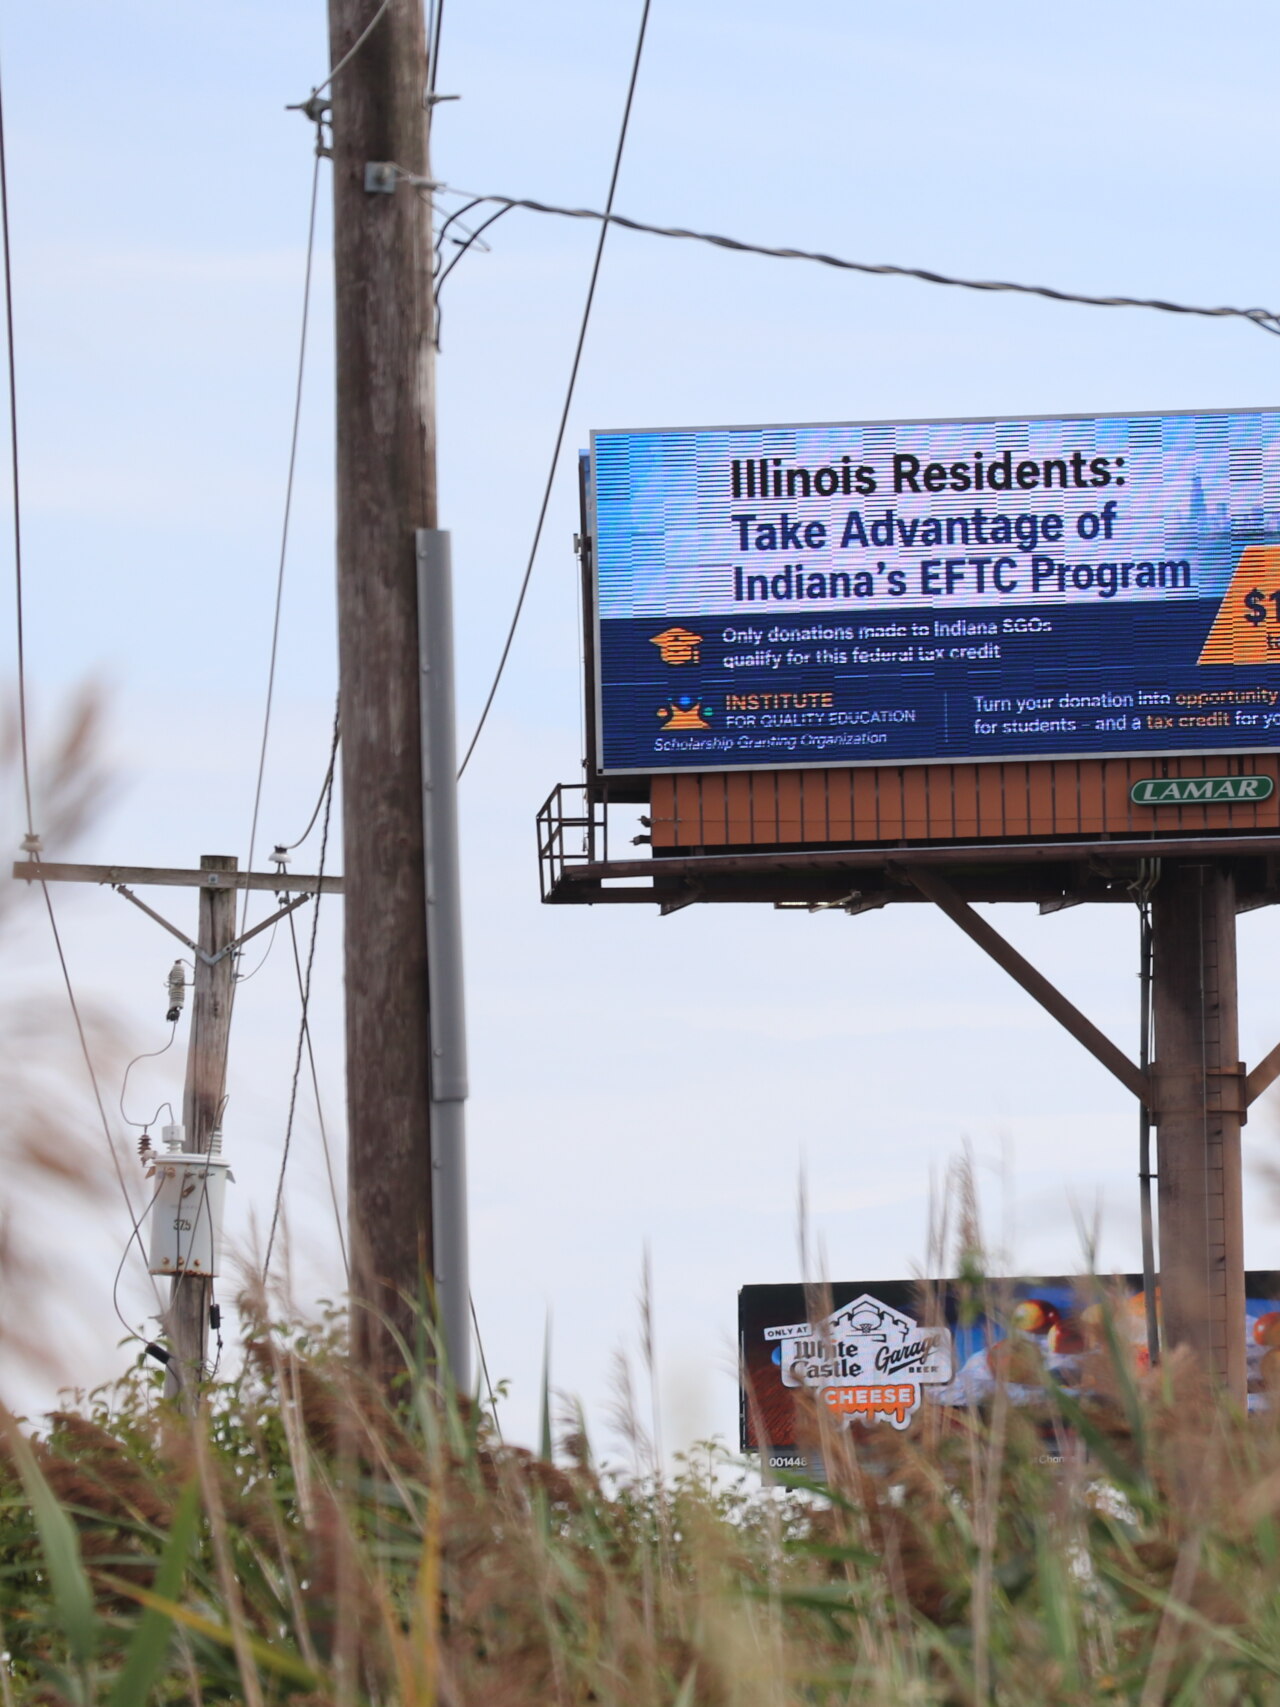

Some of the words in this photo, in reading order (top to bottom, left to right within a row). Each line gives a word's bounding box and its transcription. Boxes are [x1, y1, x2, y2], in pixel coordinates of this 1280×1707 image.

[732, 456, 876, 498] Illinois
[894, 451, 1126, 494] Residents:
[732, 512, 827, 551] Take
[840, 508, 1064, 553] Advantage
[1077, 501, 1118, 540] of
[733, 562, 907, 600] Indiana’s
[920, 557, 1018, 595] EFTC
[1031, 555, 1191, 598] Program
[722, 627, 764, 646] Only
[768, 625, 855, 642] donations
[859, 623, 906, 639] made
[912, 623, 930, 637] to
[934, 620, 998, 637] Indiana
[1002, 618, 1053, 634] SGOs
[723, 650, 783, 669] qualify
[786, 649, 811, 664] for
[816, 648, 848, 664] this
[852, 647, 914, 663] federal
[918, 647, 946, 662] tax
[950, 644, 1002, 660] credit
[725, 692, 834, 711] INSTITUTE
[974, 695, 1012, 712] Turn
[1015, 696, 1054, 714] your
[1058, 691, 1134, 709] donation
[1138, 690, 1171, 705] into
[1175, 687, 1279, 709] opportunity
[726, 714, 757, 729] FOR
[760, 712, 826, 728] QUALITY
[829, 709, 917, 725] EDUCATION
[974, 719, 997, 735] for
[1002, 717, 1077, 733] students
[1095, 715, 1127, 731] and
[1131, 718, 1142, 731] a
[1146, 714, 1173, 729] tax
[1178, 711, 1231, 728] credit
[1235, 711, 1259, 726] for
[653, 736, 734, 753] Scholarship
[737, 734, 797, 750] Granting
[800, 731, 888, 747] Organization
[1142, 779, 1259, 801] LAMAR
[767, 1328, 794, 1338] ONLY
[797, 1326, 808, 1334] AT
[793, 1340, 858, 1361] White
[874, 1334, 942, 1374] Garage
[789, 1358, 862, 1379] Castle
[908, 1366, 938, 1374] BEER
[825, 1387, 912, 1405] CHEESE
